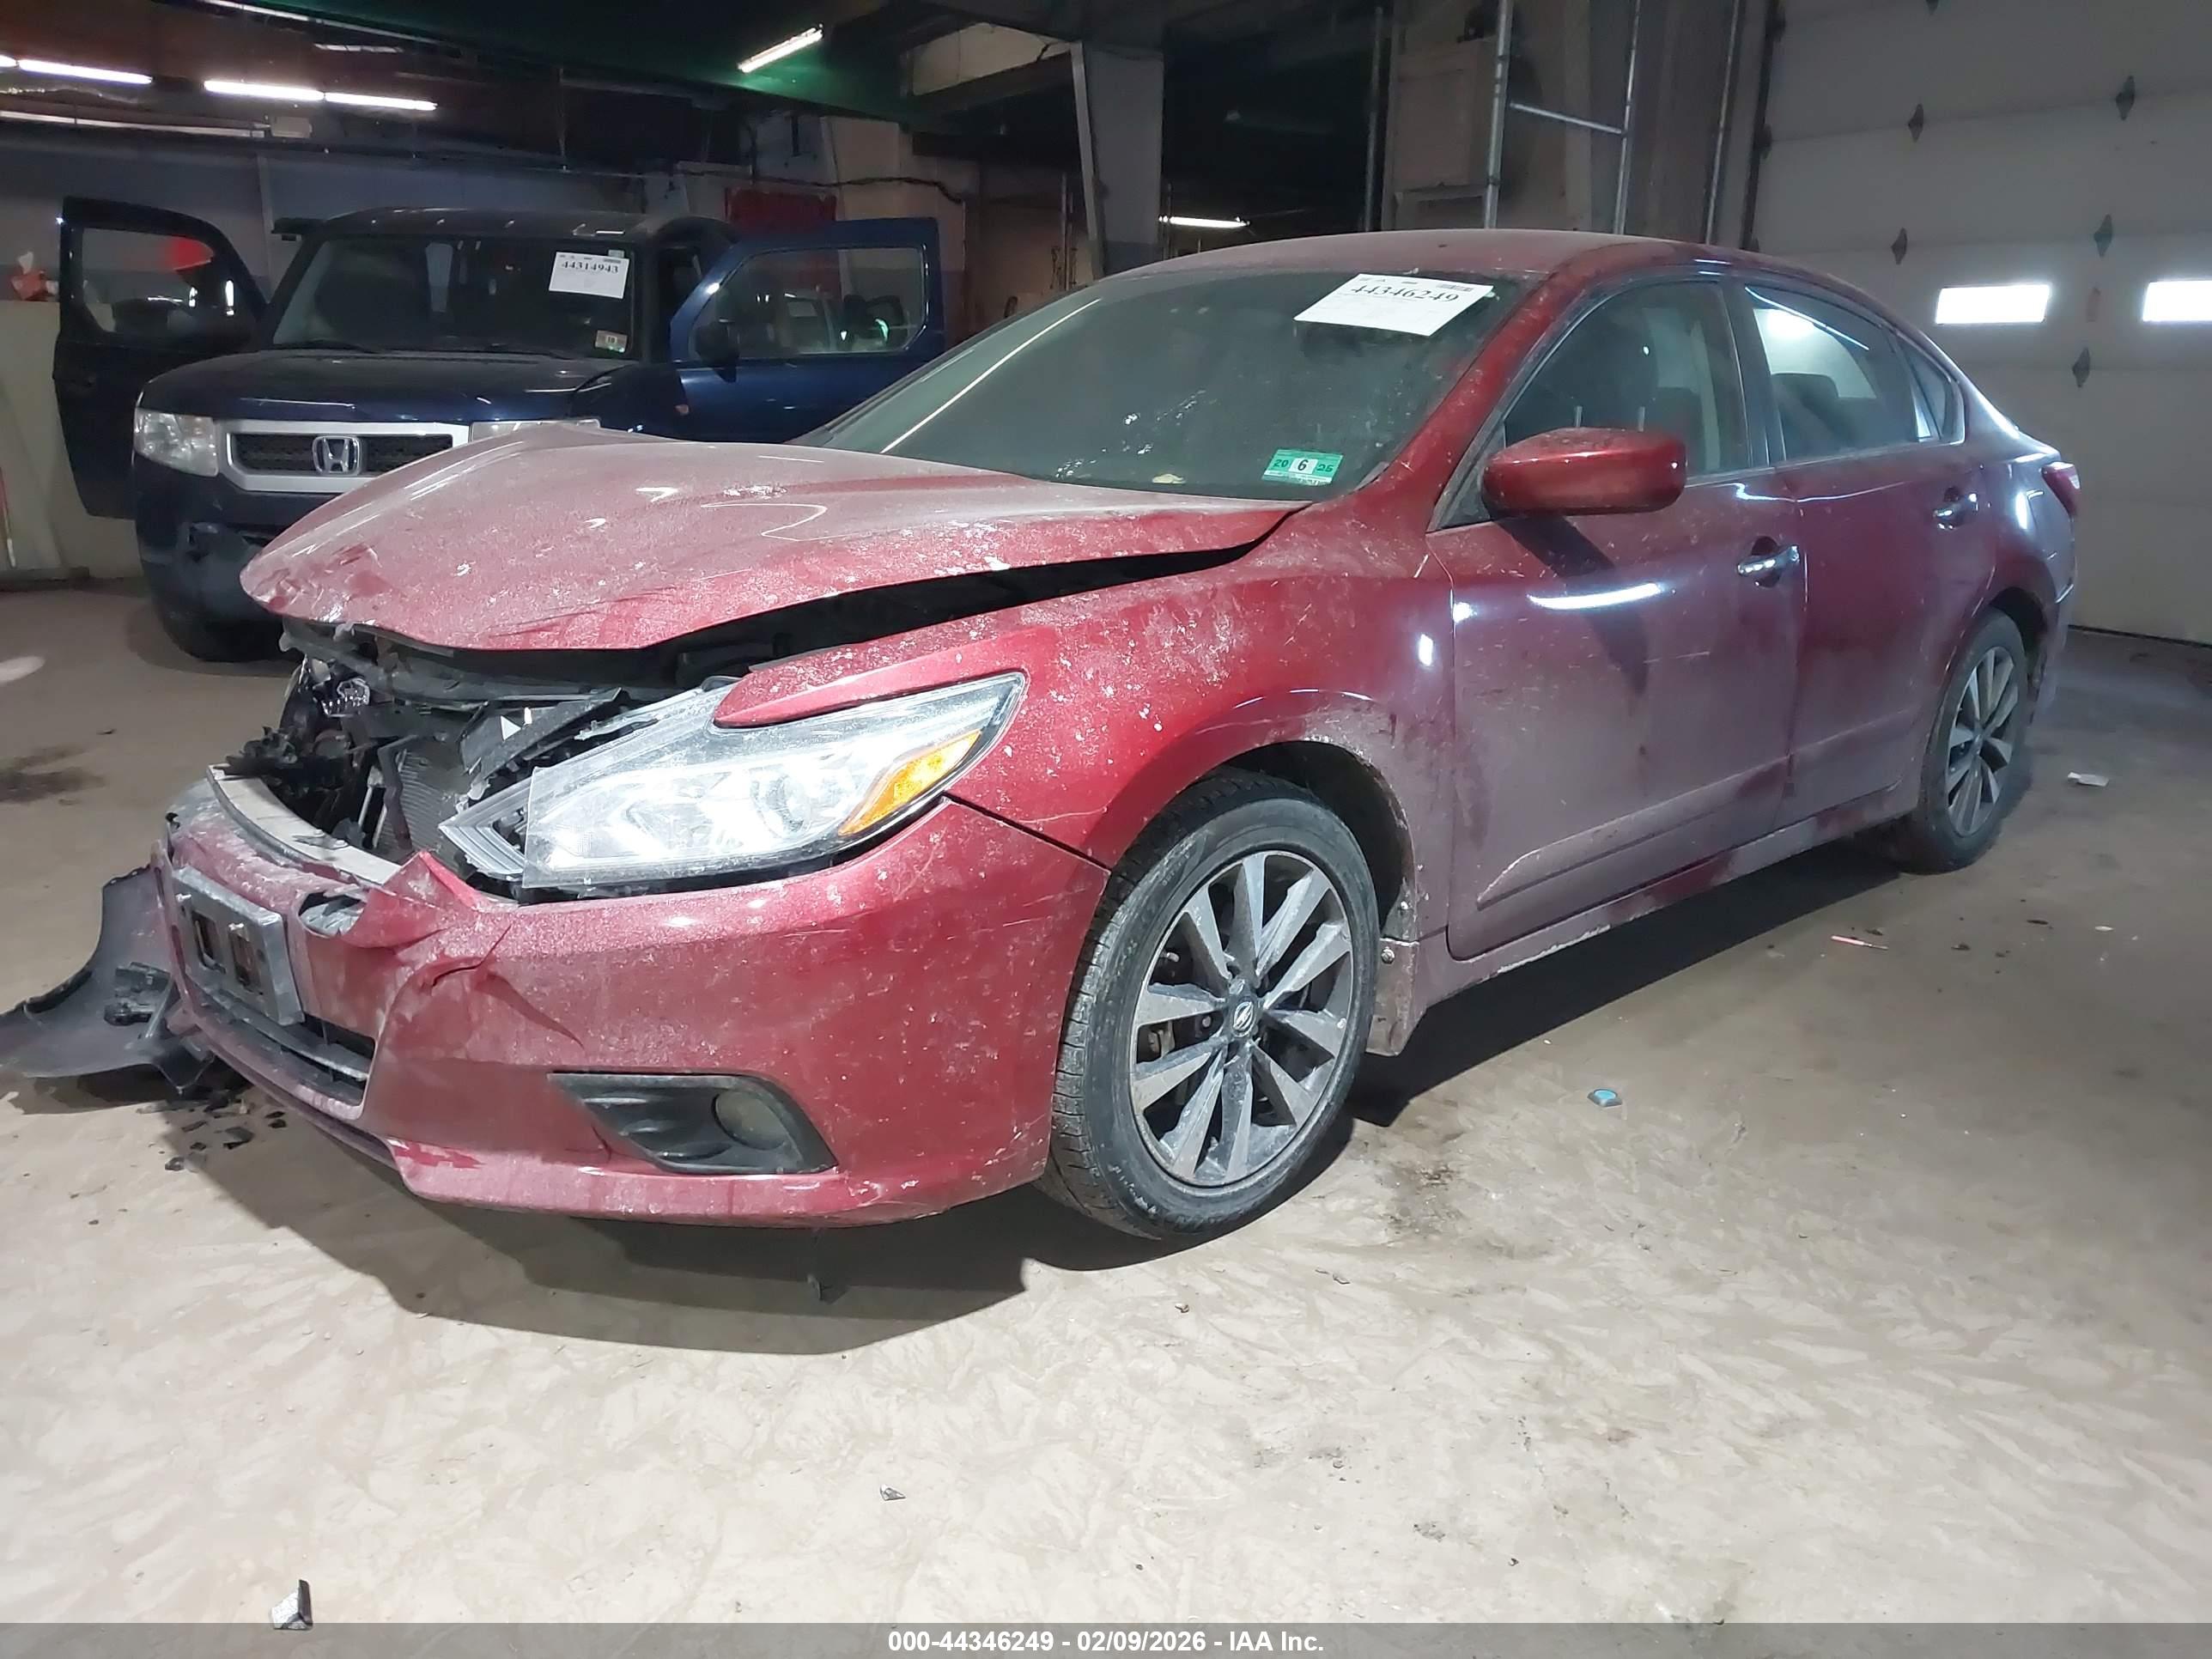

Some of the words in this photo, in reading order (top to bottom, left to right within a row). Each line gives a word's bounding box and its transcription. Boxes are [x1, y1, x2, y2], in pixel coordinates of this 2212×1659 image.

[562, 261, 618, 273] 44314943
[1352, 284, 1459, 302] 44346249
[1273, 459, 1290, 468] 20
[1297, 459, 1309, 471] 6
[1316, 464, 1334, 472] 25
